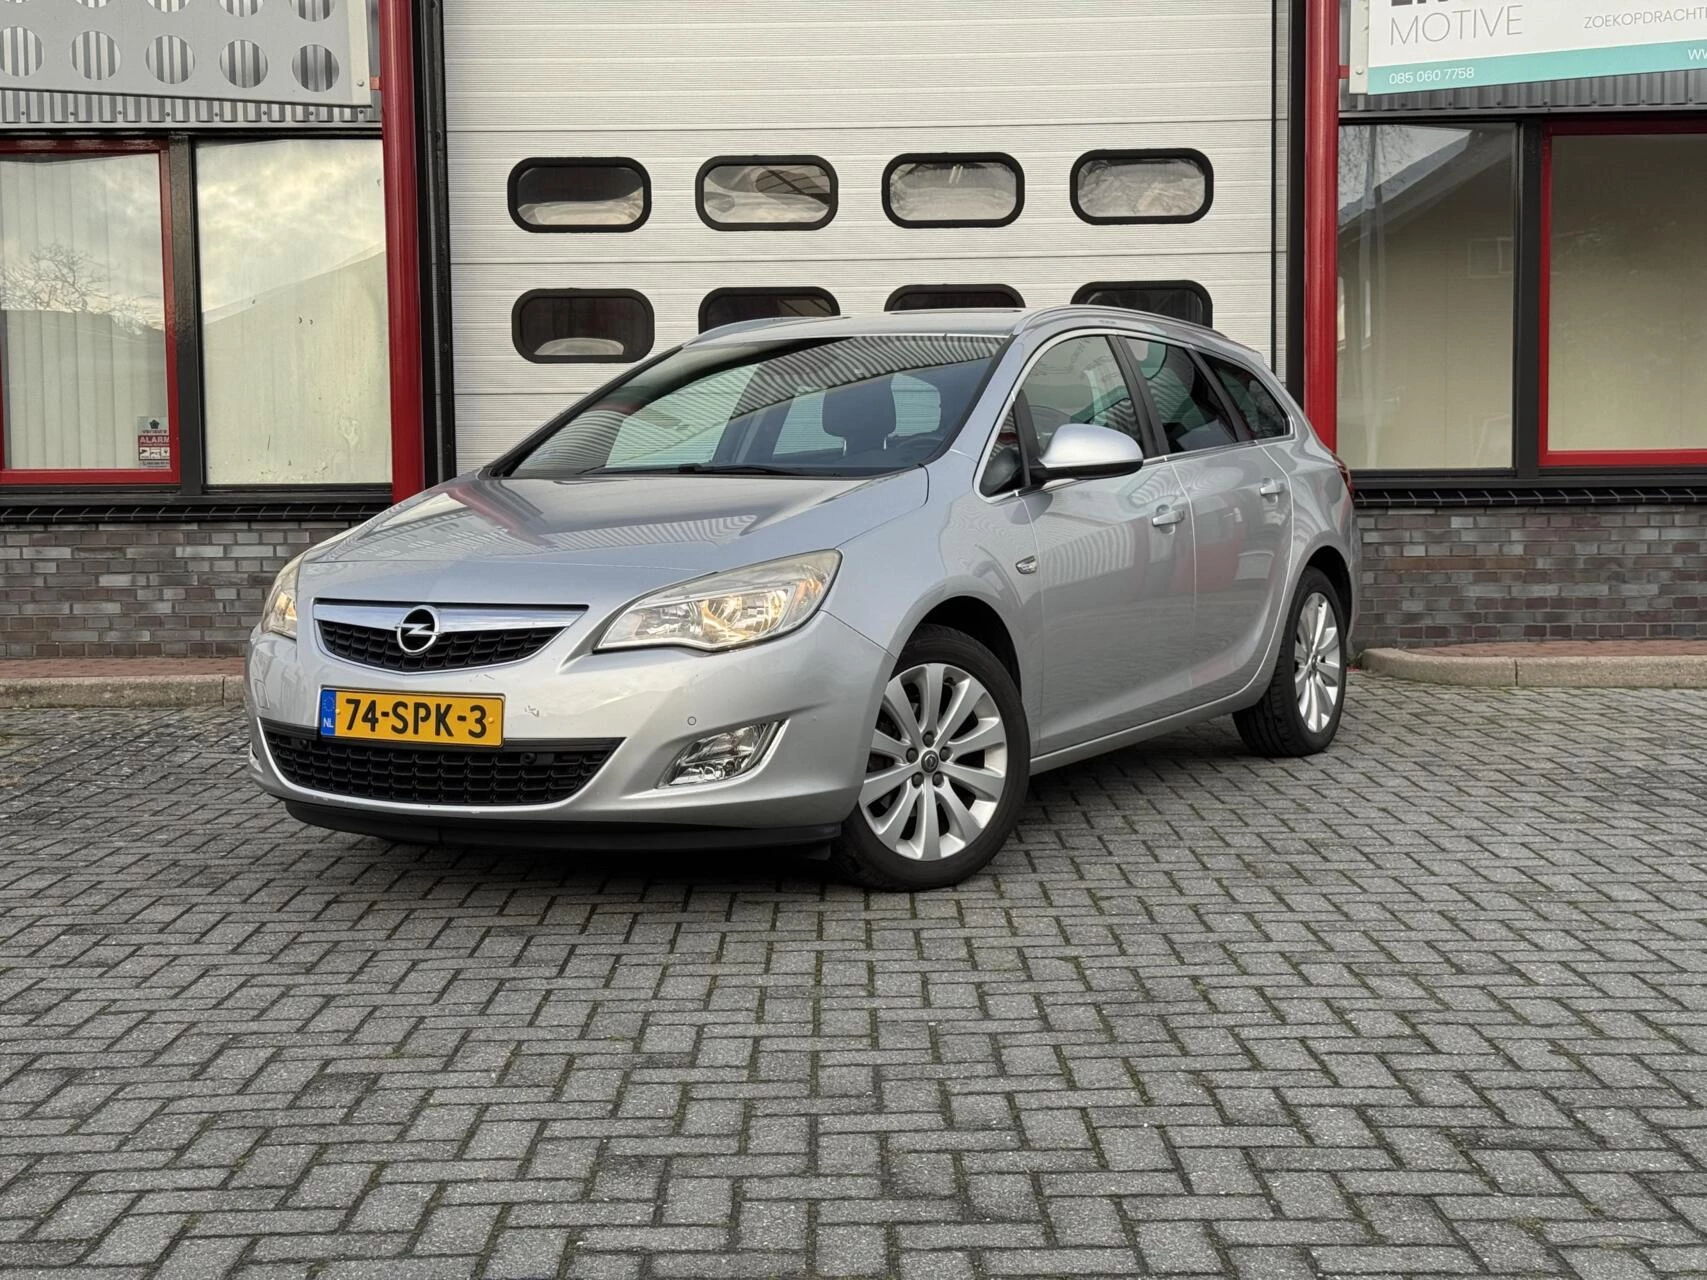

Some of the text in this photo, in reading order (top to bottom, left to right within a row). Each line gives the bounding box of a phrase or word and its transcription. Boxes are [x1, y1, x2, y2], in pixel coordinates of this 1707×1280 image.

[1391, 5, 1523, 46] MOTIVE
[1583, 6, 1707, 29] ZOEKOPDRACHT
[1389, 67, 1474, 85] 085 060 7758
[323, 718, 334, 729] NL
[345, 698, 488, 739] 74-SPK-3
